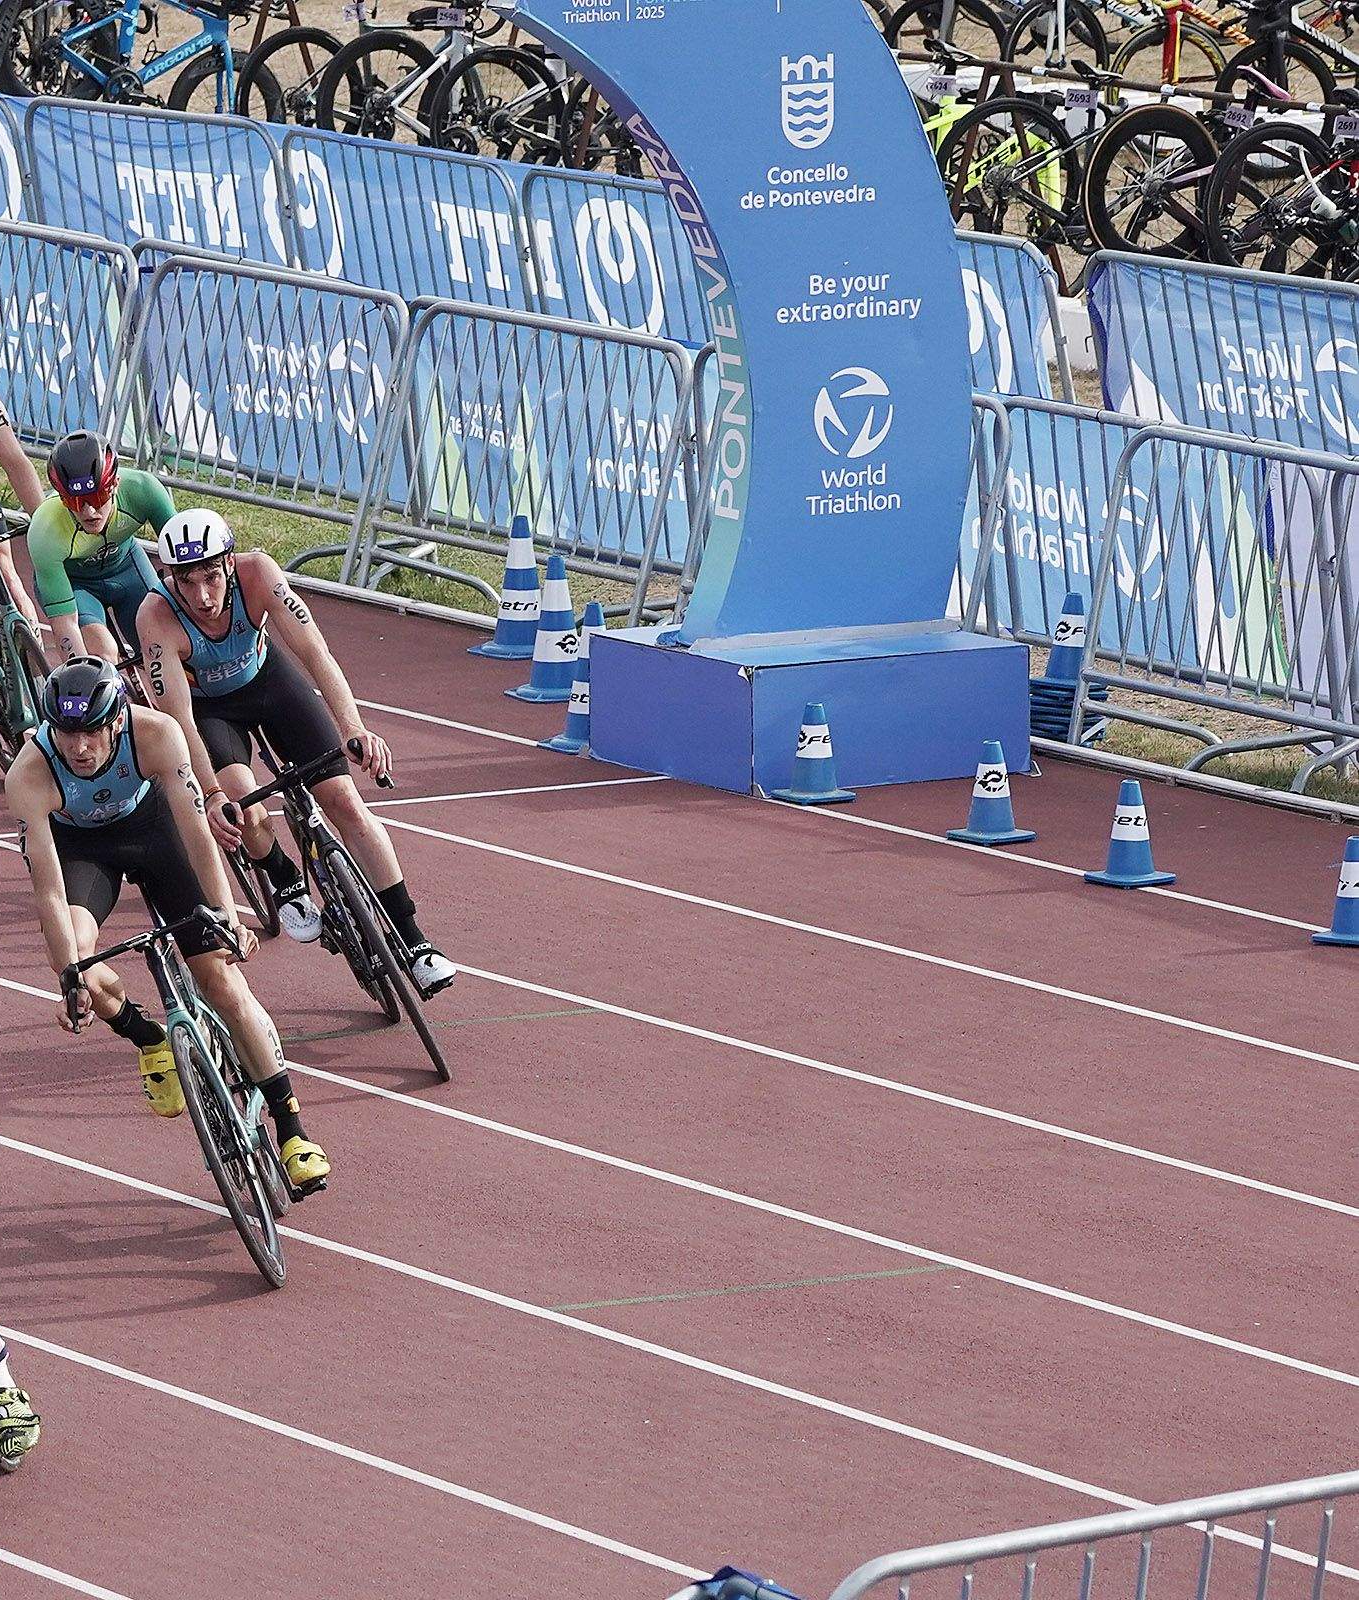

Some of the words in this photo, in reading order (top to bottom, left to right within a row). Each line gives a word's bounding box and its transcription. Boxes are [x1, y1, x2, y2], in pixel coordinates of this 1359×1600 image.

[563, 8, 620, 24] Triathlon
[636, 6, 665, 20] 2025
[145, 46, 194, 82] ARGON
[1068, 93, 1092, 104] 2693
[1227, 110, 1247, 124] 2692
[1338, 121, 1358, 131] 2691
[767, 163, 848, 186] Concello
[740, 189, 764, 211] de
[769, 183, 877, 209] Pontevedra
[809, 275, 836, 296] Be
[843, 273, 890, 301] your
[629, 115, 746, 521] PONTEVEDRA
[776, 293, 922, 325] extraordinary
[822, 464, 887, 490] World
[806, 490, 901, 517] Triathlon
[179, 546, 189, 556] 29
[283, 597, 311, 626] 29
[149, 660, 166, 697] 29
[62, 700, 73, 711] 19
[267, 1028, 284, 1068] 19
